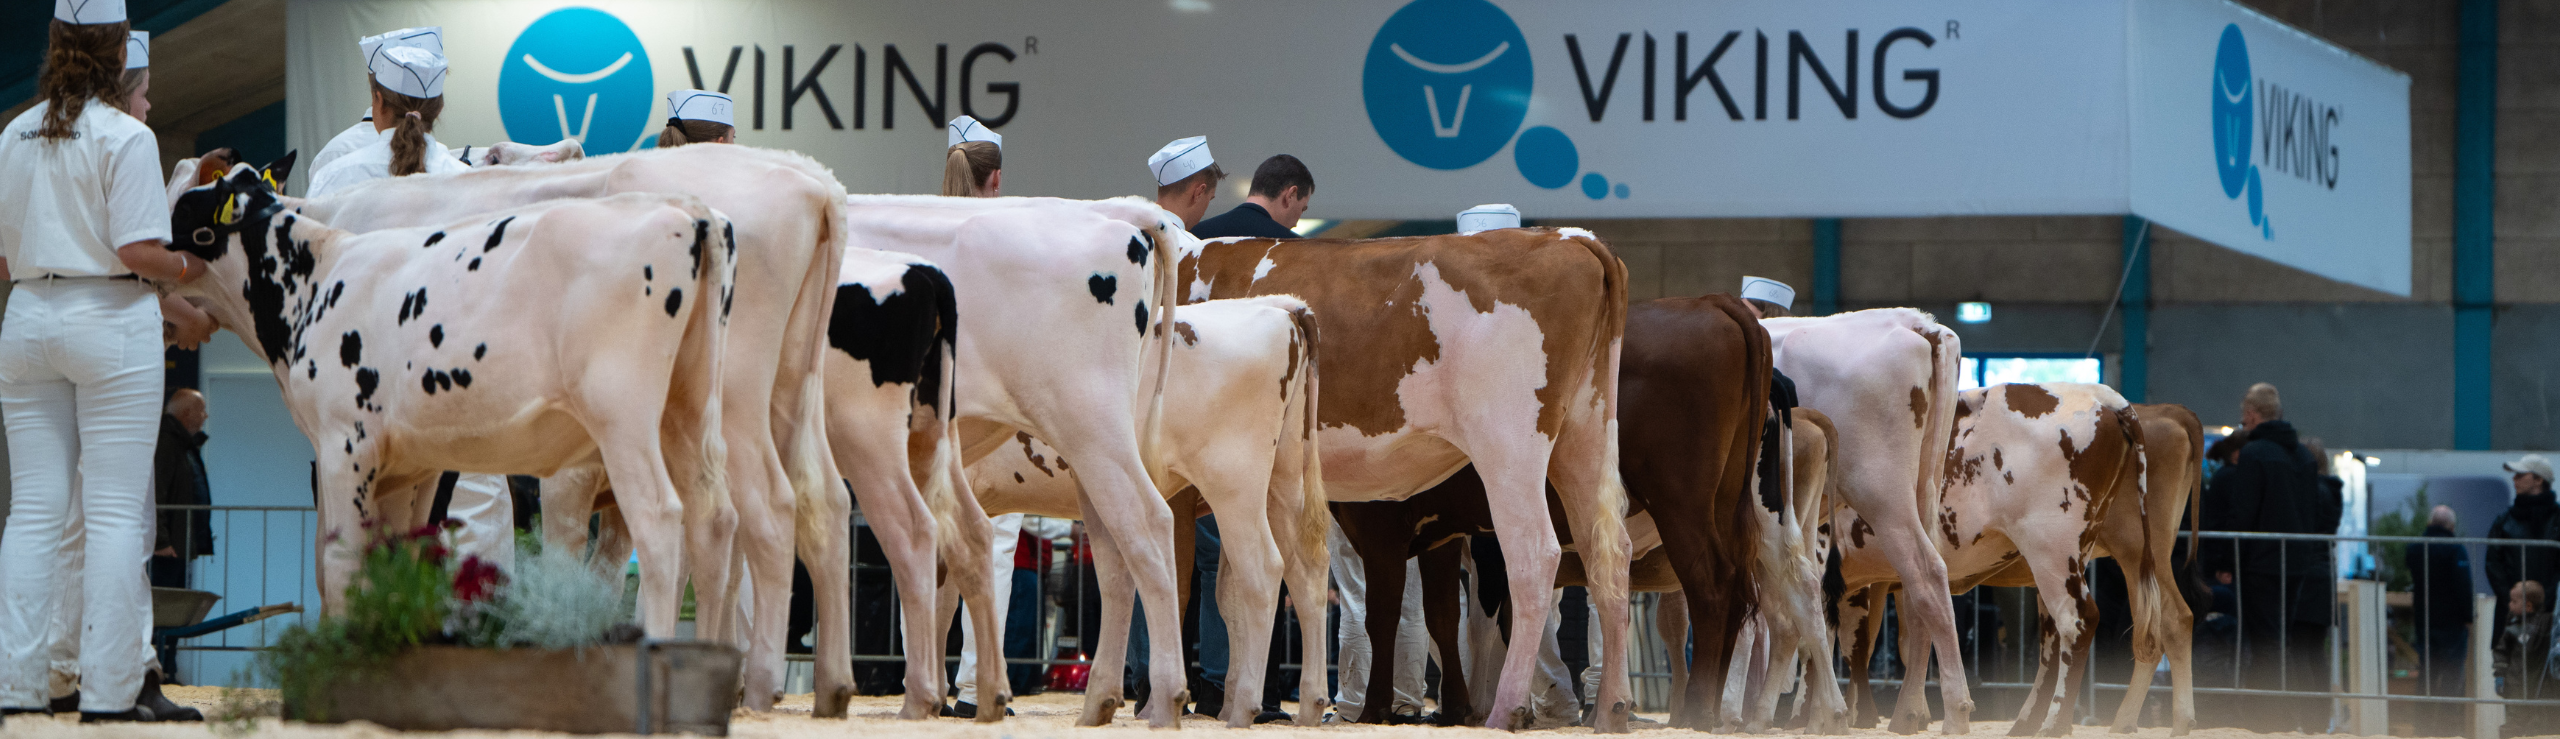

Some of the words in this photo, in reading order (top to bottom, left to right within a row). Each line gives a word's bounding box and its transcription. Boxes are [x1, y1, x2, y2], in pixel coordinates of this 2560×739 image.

[682, 42, 1020, 130] VIKING
[1563, 26, 1940, 122] VIKING
[2260, 78, 2339, 190] VIKING
